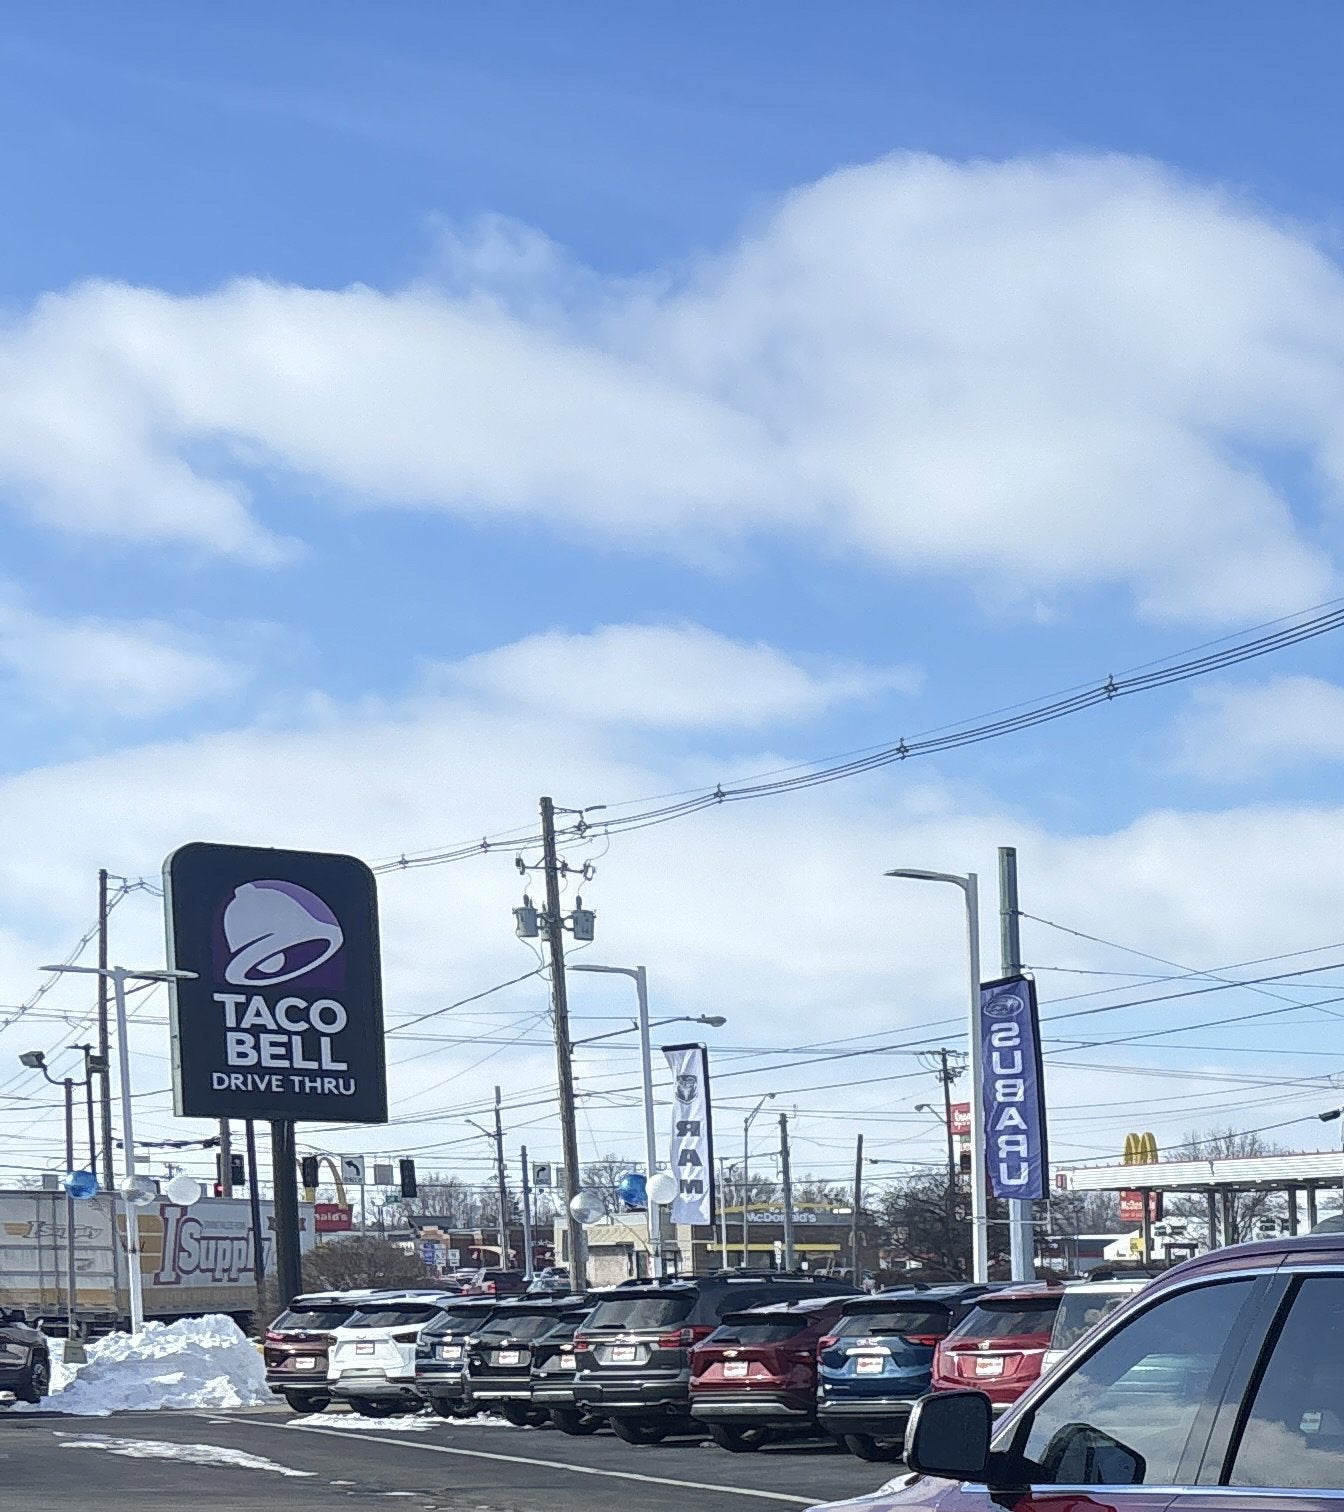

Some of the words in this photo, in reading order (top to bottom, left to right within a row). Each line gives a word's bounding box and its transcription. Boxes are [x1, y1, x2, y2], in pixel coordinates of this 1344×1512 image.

[213, 993, 347, 1034] TACO
[226, 1031, 348, 1071] BELL
[212, 1072, 285, 1092] DRIVE
[290, 1076, 356, 1096] THRU
[314, 1212, 348, 1221] nald's
